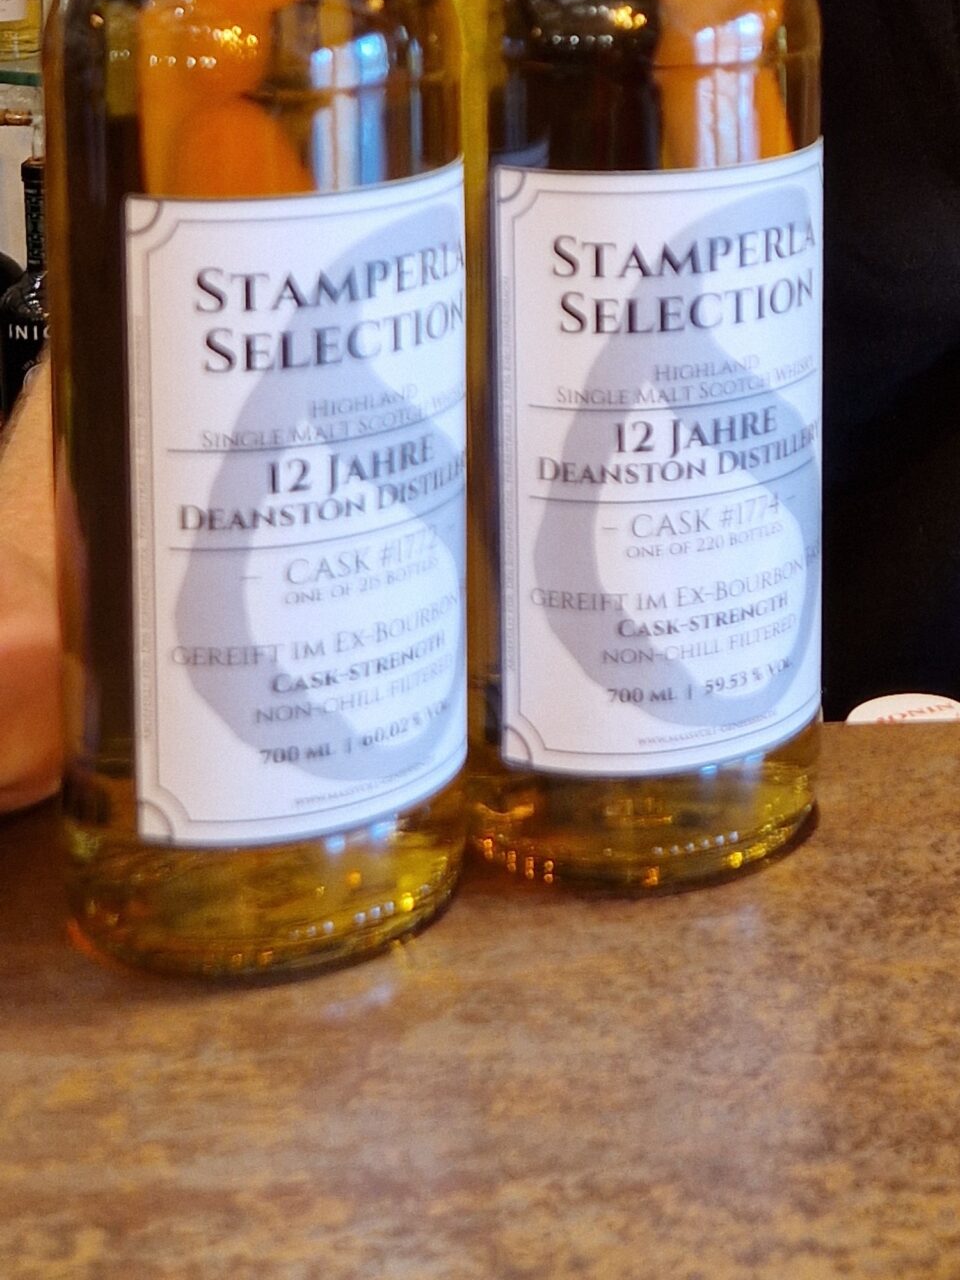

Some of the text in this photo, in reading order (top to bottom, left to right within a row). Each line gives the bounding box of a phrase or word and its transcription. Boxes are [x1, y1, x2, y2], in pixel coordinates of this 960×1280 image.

[551, 220, 816, 279] STAMPERLA
[195, 240, 464, 313] STAMPERLA
[559, 267, 815, 335] SELECTION
[204, 290, 464, 374] SELECTION
[655, 354, 760, 384] HIGHLAND
[556, 387, 629, 405] SINGLE
[615, 405, 778, 458] 12 JAHRE
[266, 434, 435, 495] 12 JAHRE
[537, 455, 706, 486] DEANSTON
[179, 494, 367, 531] DEANSTON
[631, 508, 714, 540] CASK
[286, 548, 371, 586] CASK
[626, 543, 664, 559] ONE
[669, 541, 692, 556] OF
[530, 585, 630, 612] GEREIFT
[636, 592, 668, 612] IM
[676, 556, 805, 608] EX-BOURBON
[617, 592, 790, 638] CASK-STRENGTH
[170, 642, 284, 667] GEREIFT
[601, 643, 723, 664] NON-CHILL
[606, 686, 645, 703] 700
[258, 746, 299, 765] 700
